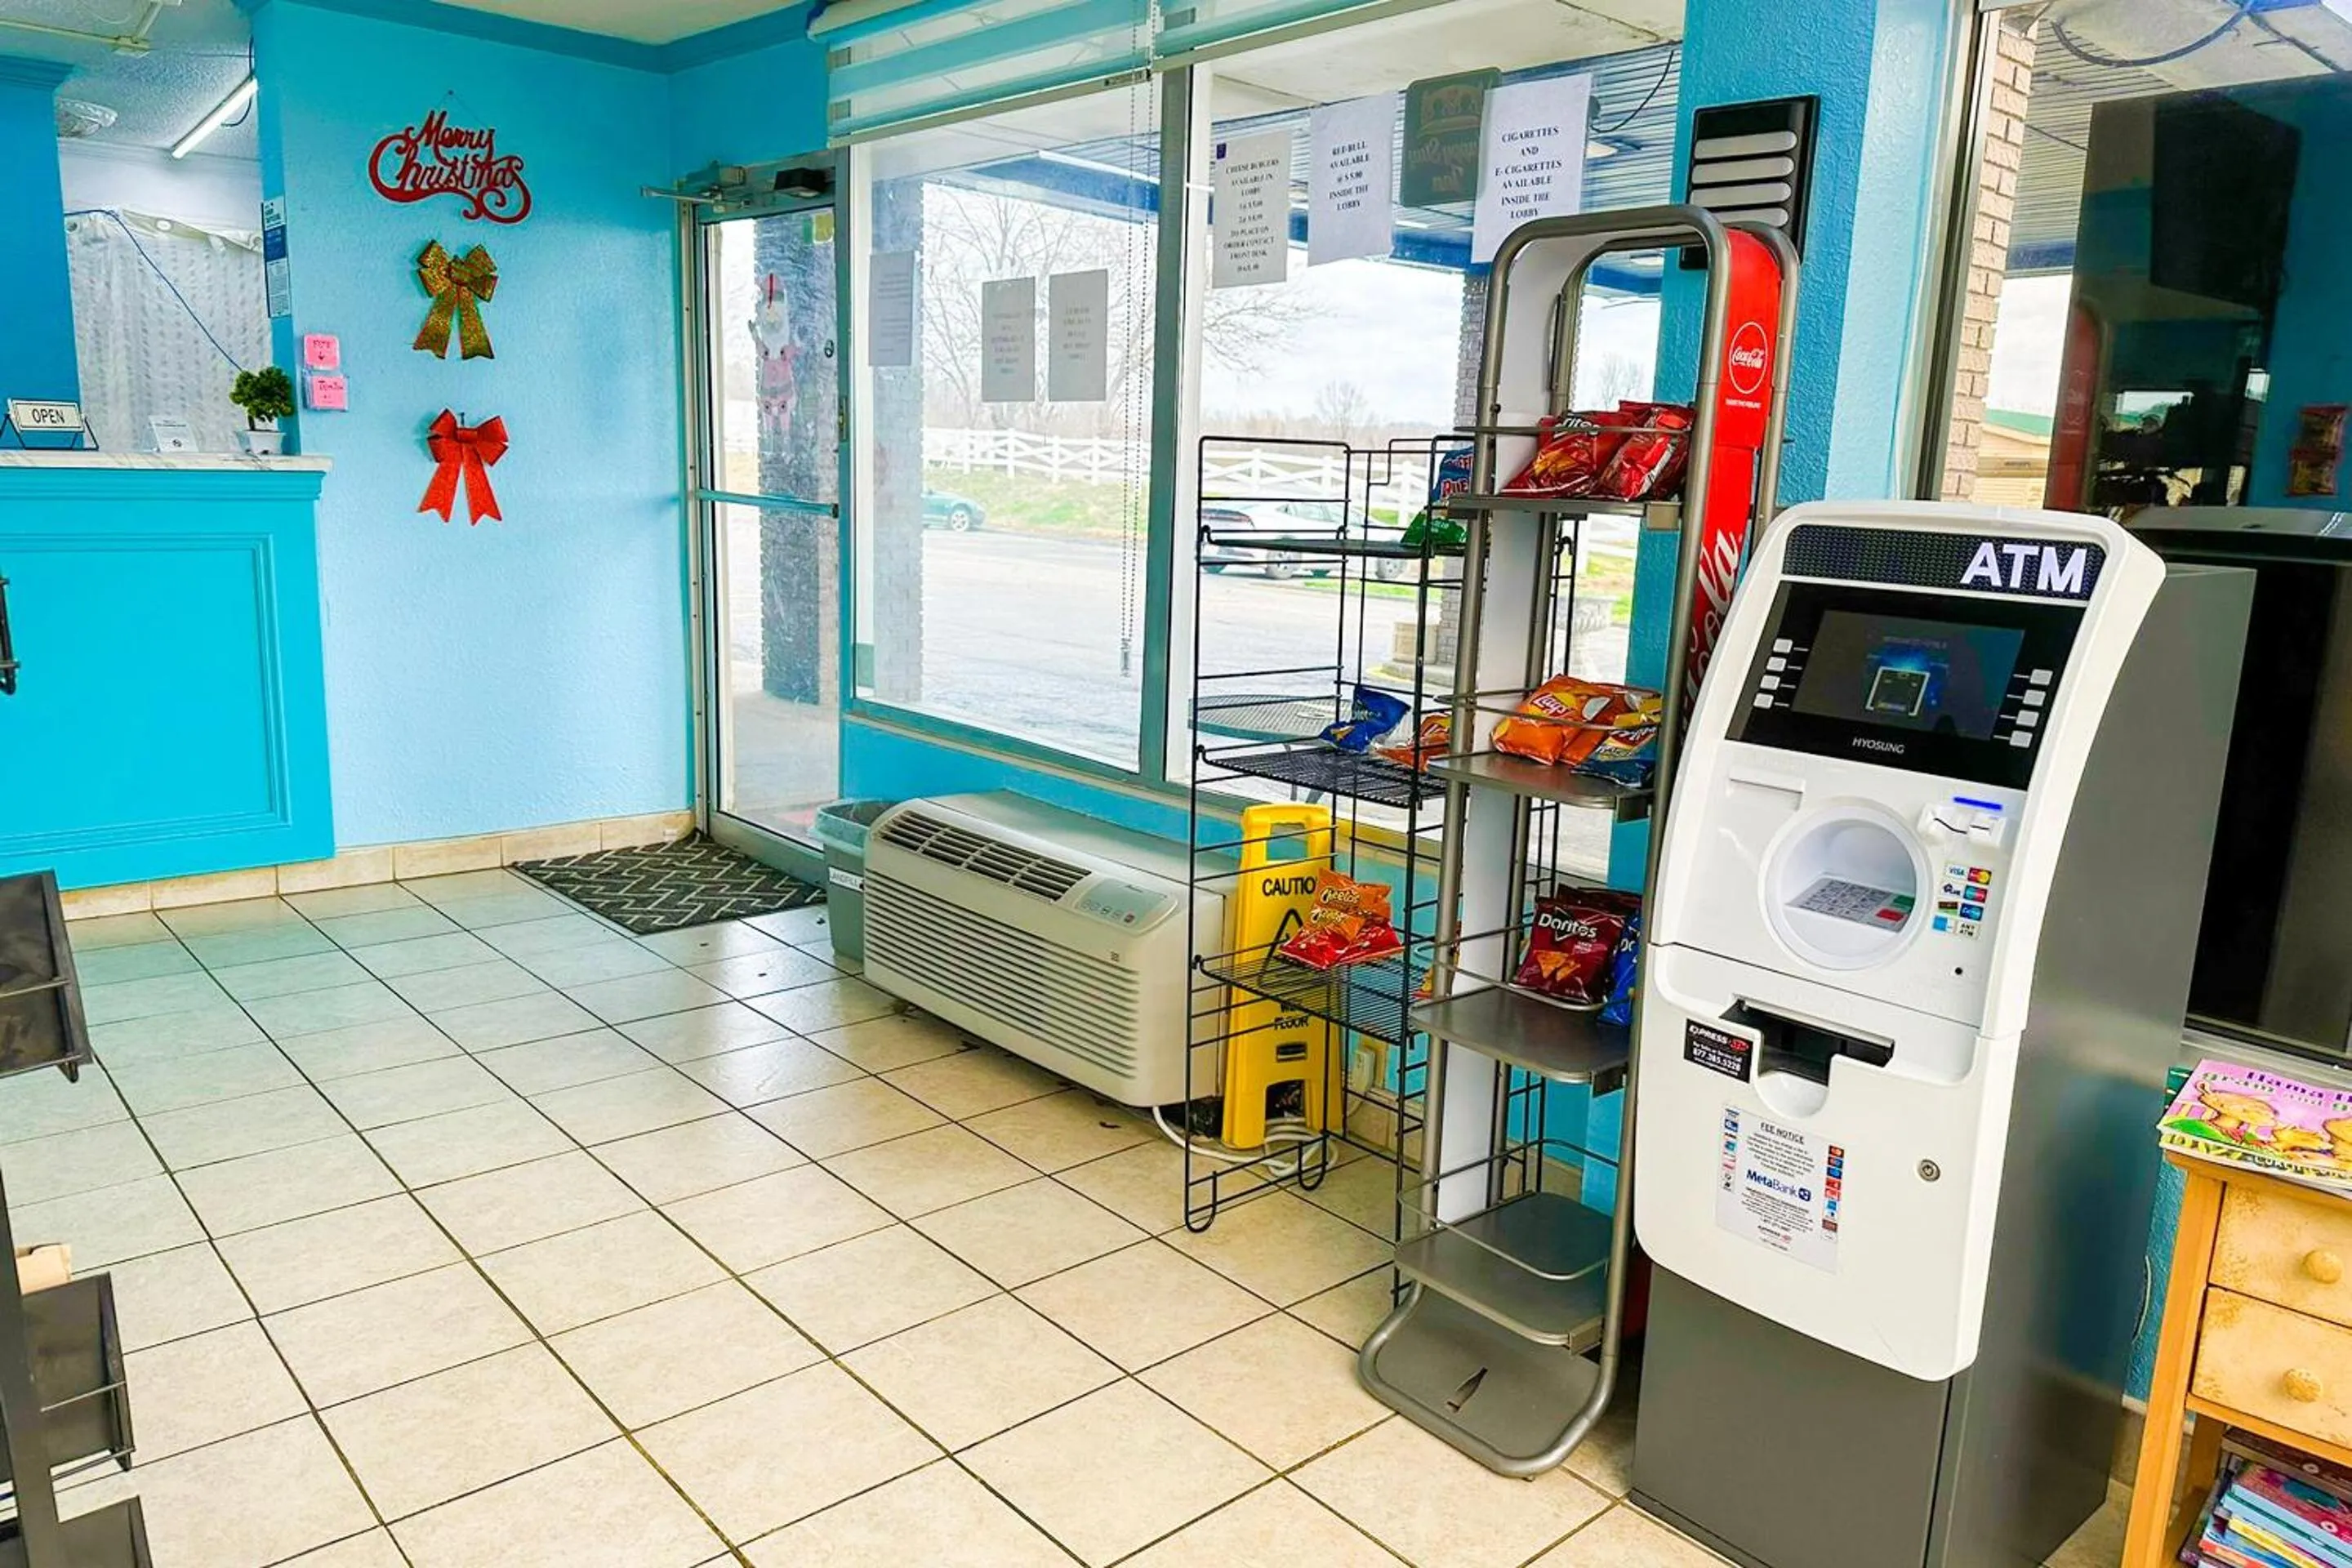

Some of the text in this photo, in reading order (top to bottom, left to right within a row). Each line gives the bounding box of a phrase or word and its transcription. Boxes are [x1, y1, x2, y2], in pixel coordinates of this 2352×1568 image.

[404, 109, 496, 166] Merry
[1501, 125, 1560, 143] CIGARETTES
[1521, 146, 1539, 156] AND
[1330, 154, 1369, 169] AVAILABLE
[369, 133, 532, 224] Christmas
[1503, 176, 1552, 189] AVAILABLE
[1329, 185, 1369, 199] INSIDE THE
[1501, 192, 1550, 207] INSIDE THE
[1337, 200, 1361, 211] LOBBY
[1510, 207, 1539, 219] LOBBY
[32, 408, 65, 425] OPEN
[1960, 541, 2088, 594] ATM
[1852, 737, 1905, 754] HYOSUNG
[1949, 867, 1965, 876] VISA
[1263, 876, 1318, 897] CAUTIO
[1539, 912, 1598, 938] Doritos
[1760, 1121, 1805, 1145] FEE NOTICE
[1746, 1169, 1798, 1198] MetaBank
